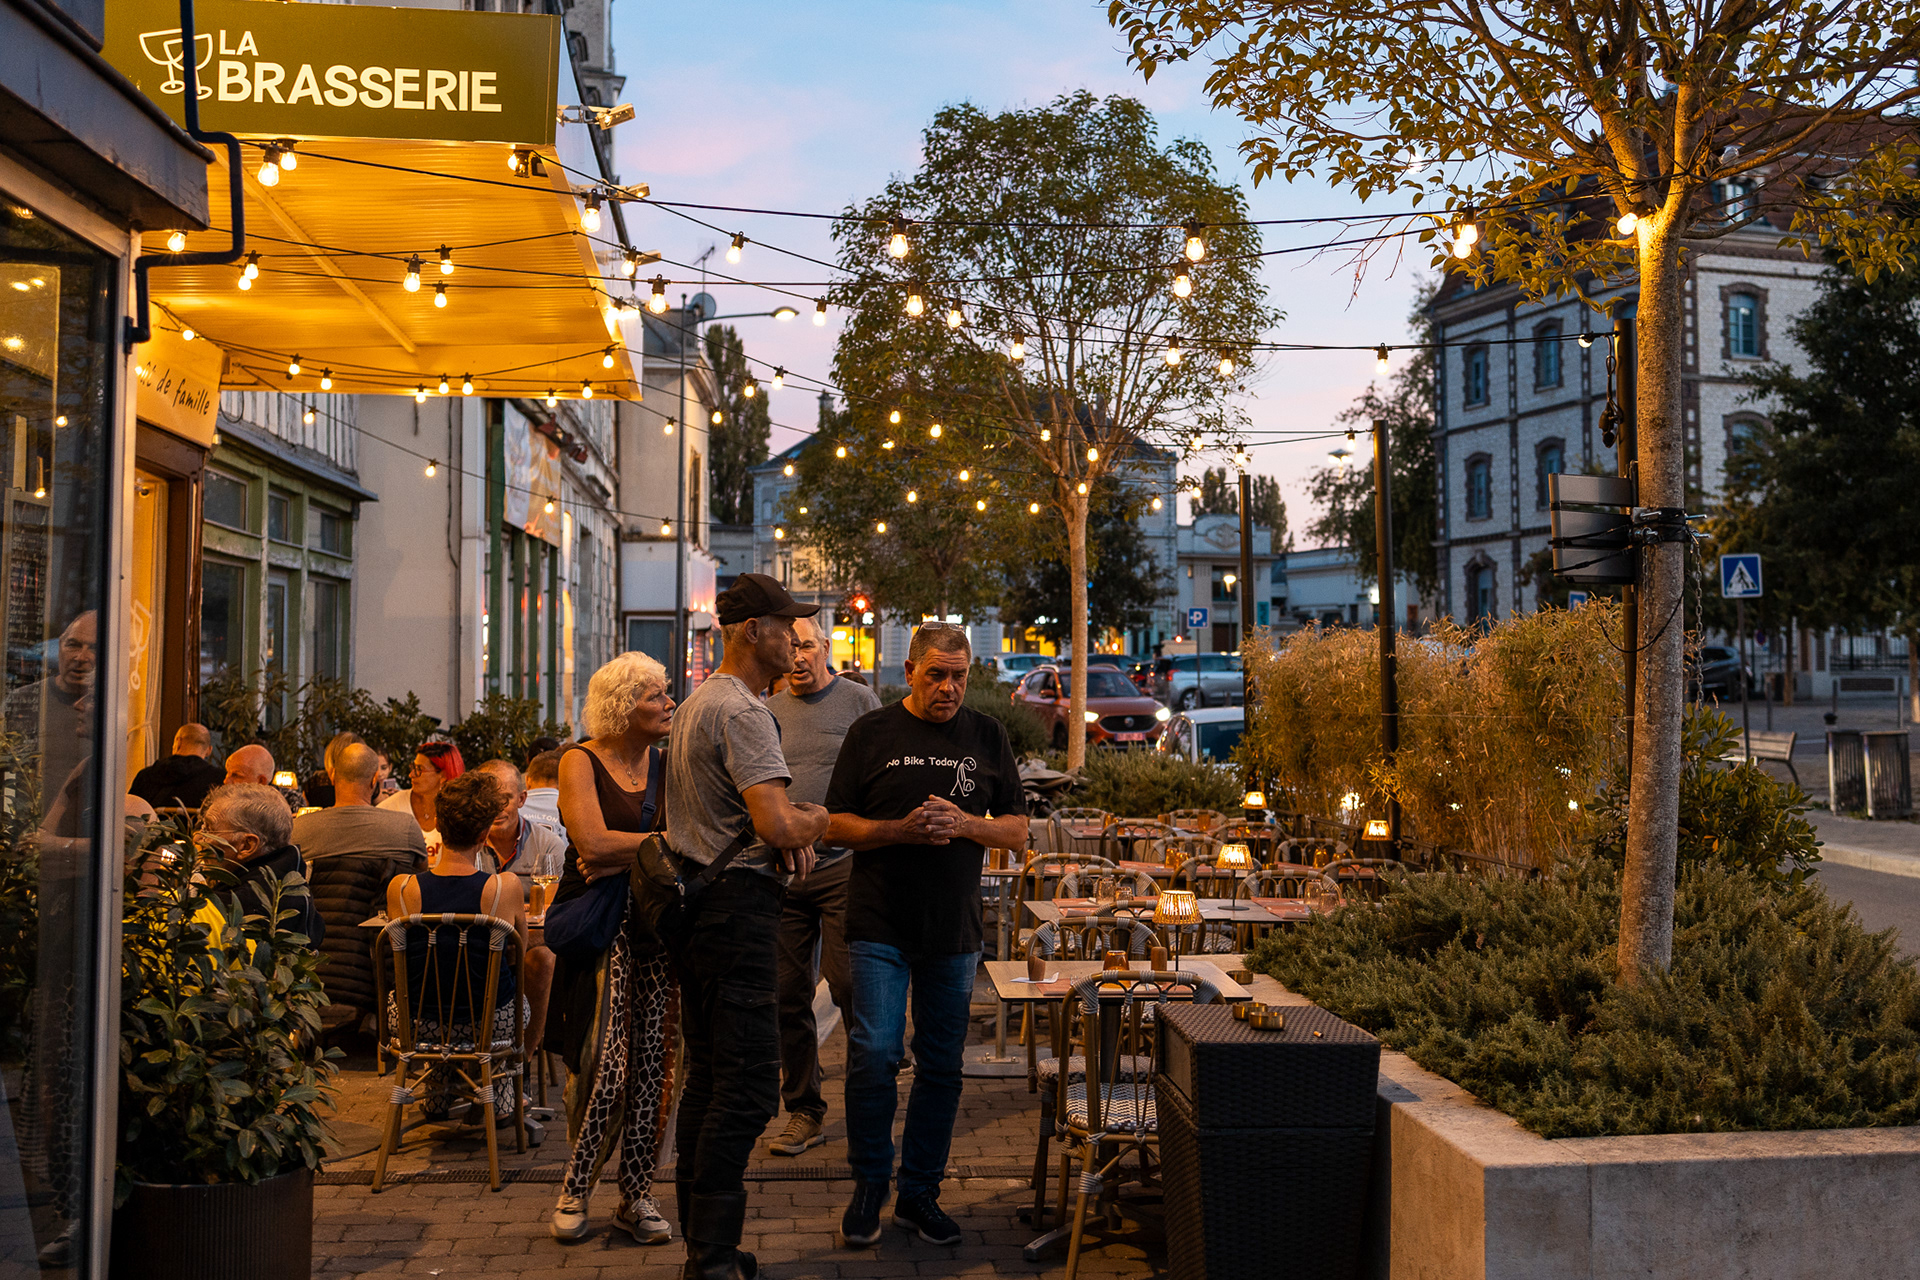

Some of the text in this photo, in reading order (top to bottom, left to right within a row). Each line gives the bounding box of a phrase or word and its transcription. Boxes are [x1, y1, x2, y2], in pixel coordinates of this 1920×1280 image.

[219, 29, 260, 57] LA
[217, 59, 503, 113] BRASSERIE
[156, 368, 172, 395] de
[172, 378, 210, 416] famille
[1193, 611, 1203, 625] P
[886, 755, 959, 769] No Bike Today
